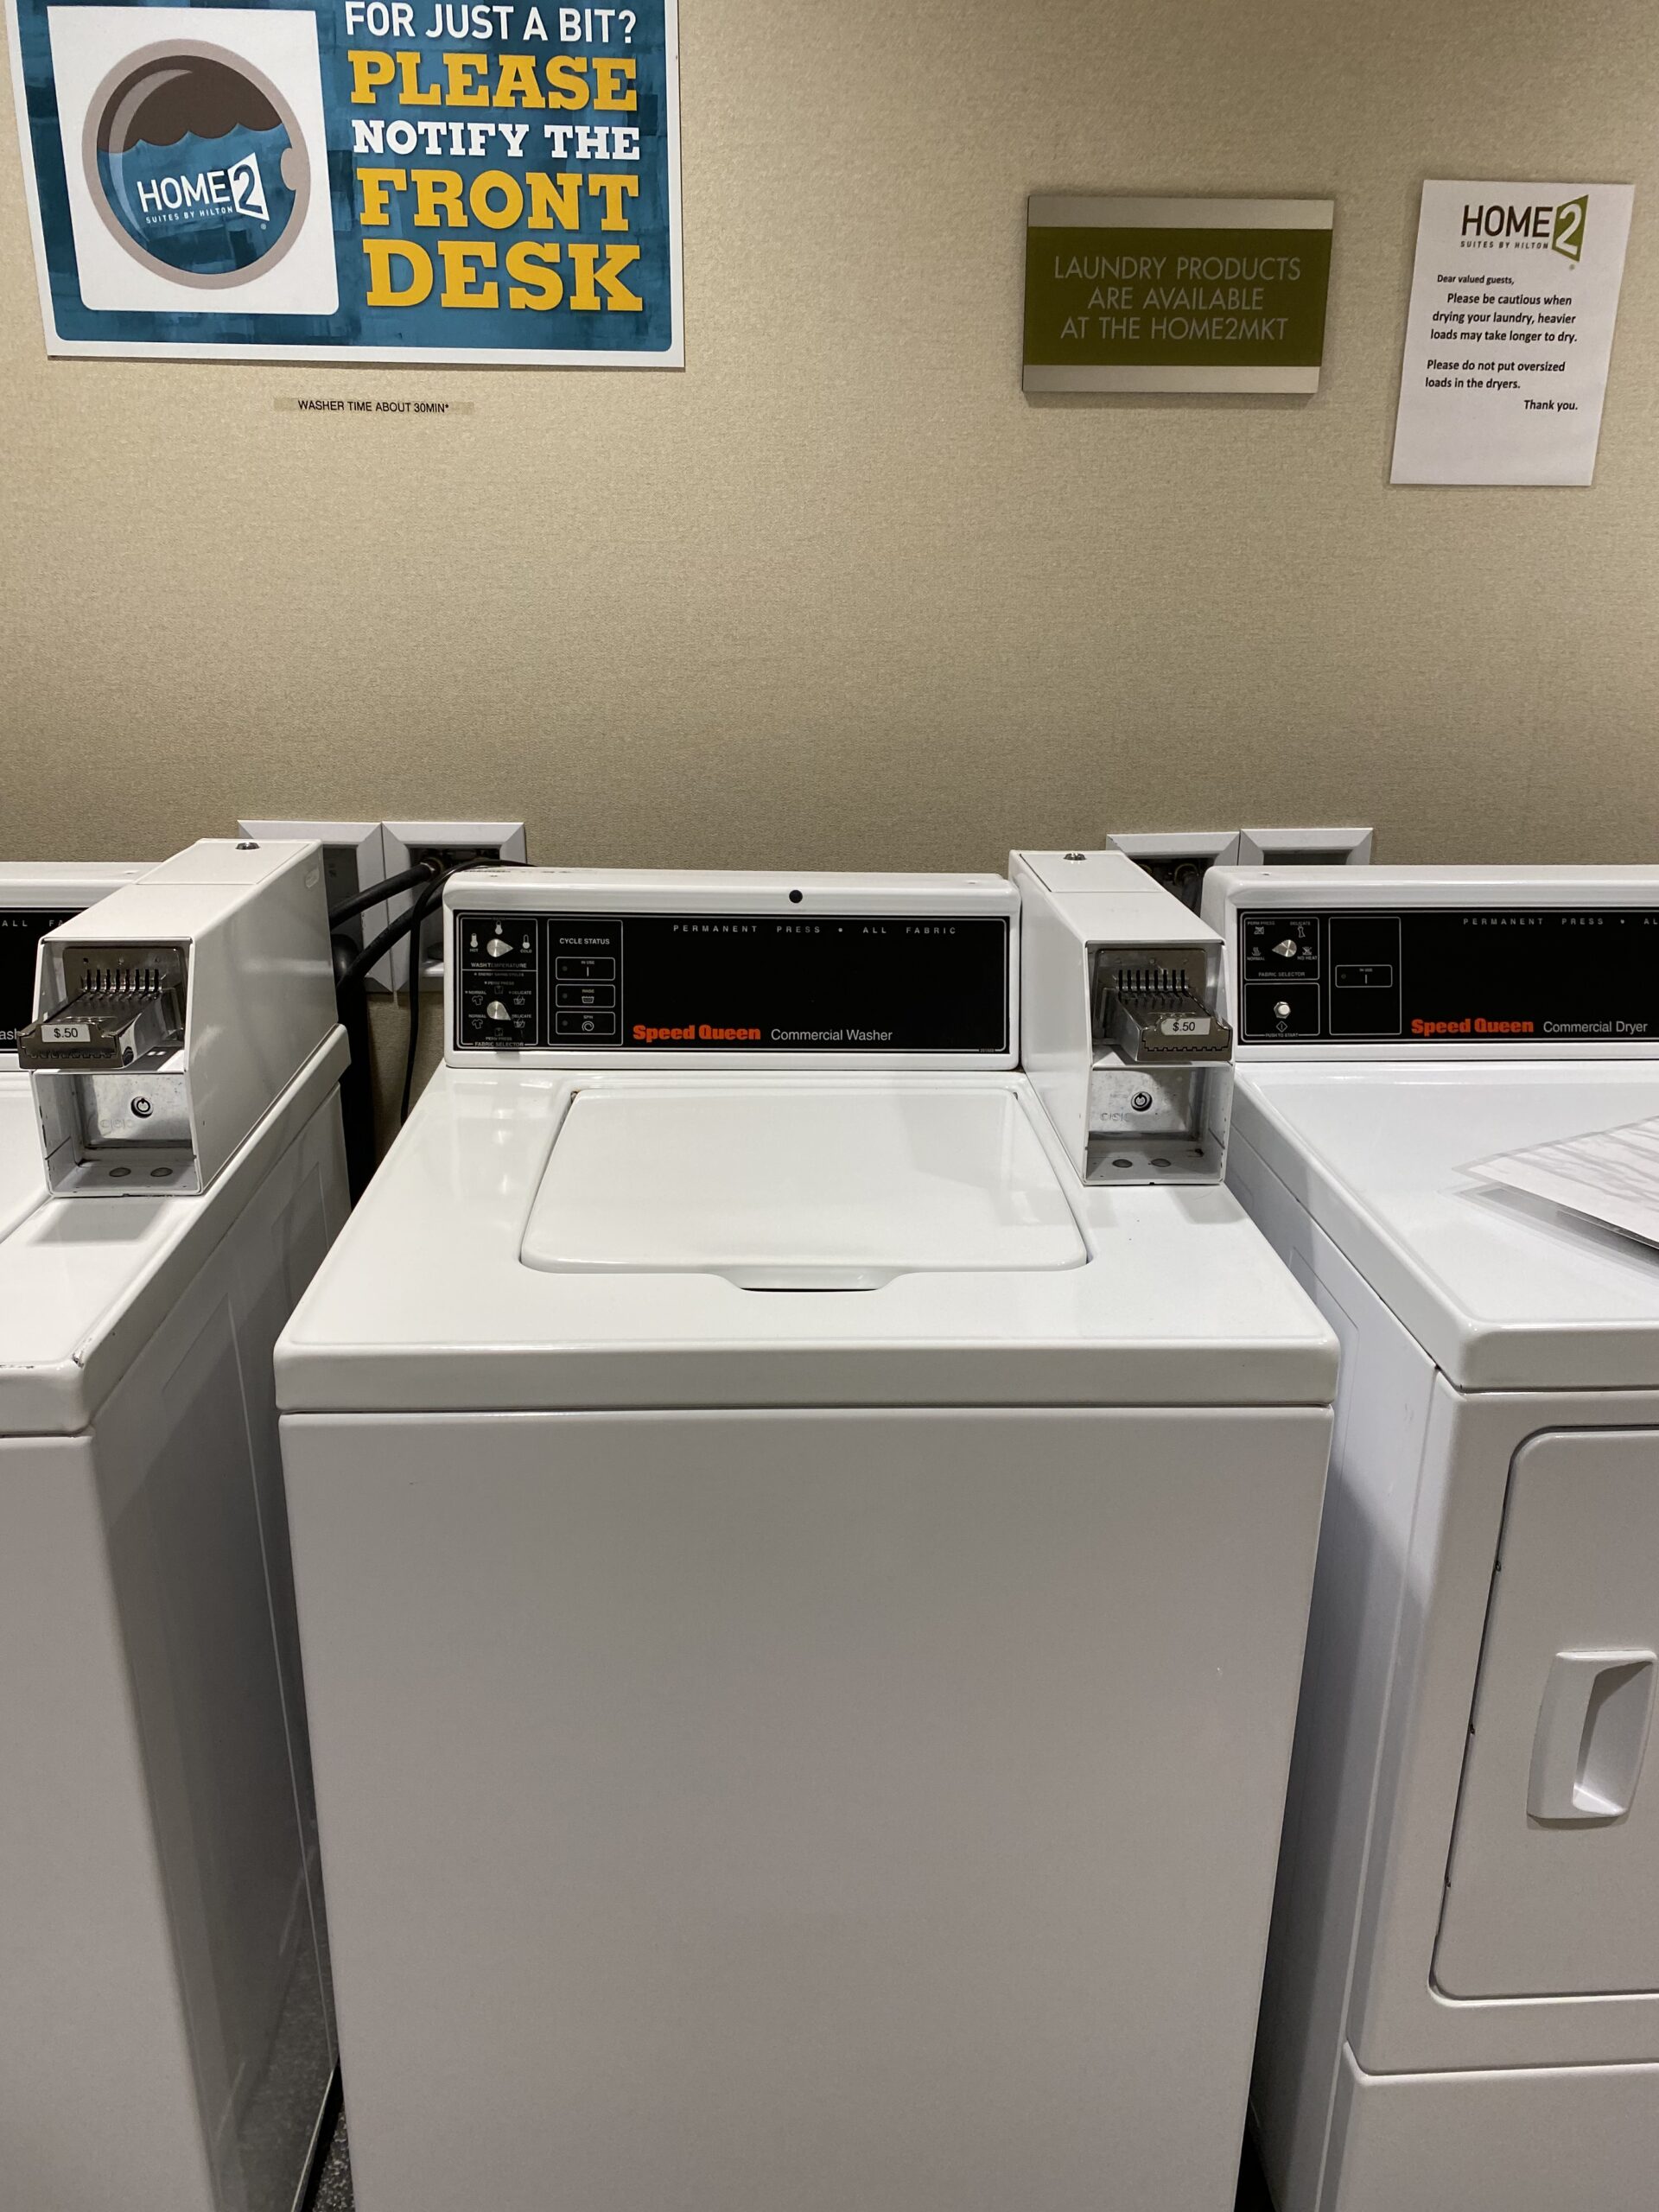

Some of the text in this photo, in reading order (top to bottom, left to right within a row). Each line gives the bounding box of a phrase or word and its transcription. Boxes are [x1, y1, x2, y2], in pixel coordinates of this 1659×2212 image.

[346, 1, 637, 43] FOR JUST A BIT?
[347, 50, 638, 111] PLEASE
[352, 119, 640, 160] NOTIFY THE
[356, 168, 639, 231] FRONT
[146, 206, 233, 224] SUITES BY HILTON
[1460, 240, 1494, 249] SUITES
[1515, 241, 1549, 250] HILTON
[363, 238, 643, 311] DESK
[1054, 256, 1301, 281] LAUNDRY PRODUCTS
[1437, 274, 1515, 286] Dear valued guests,
[1087, 286, 1265, 310] ARE AVAILABLE
[1446, 292, 1573, 306] Please be cautious when
[1432, 310, 1577, 326] drying your laundry, heavier
[1060, 316, 1289, 340] AT THE HOME2MKT
[1430, 328, 1579, 345] loads may take longer to dry.
[1427, 359, 1566, 373] Please do not put oversized
[1425, 377, 1521, 391] loads in the dryers.
[298, 399, 345, 411] WASHER
[347, 400, 372, 412] TIME
[375, 401, 412, 413] ABOUT
[1523, 399, 1579, 413] Thank you.
[673, 924, 957, 935] PERMANENT PRESS ALL FABRIC
[54, 1027, 79, 1039] $.50
[632, 1024, 893, 1042] Speed Queen Commercial Washer
[1172, 1021, 1196, 1033] $.50
[1411, 1017, 1648, 1036] Speed Queen Commercial Dryer
